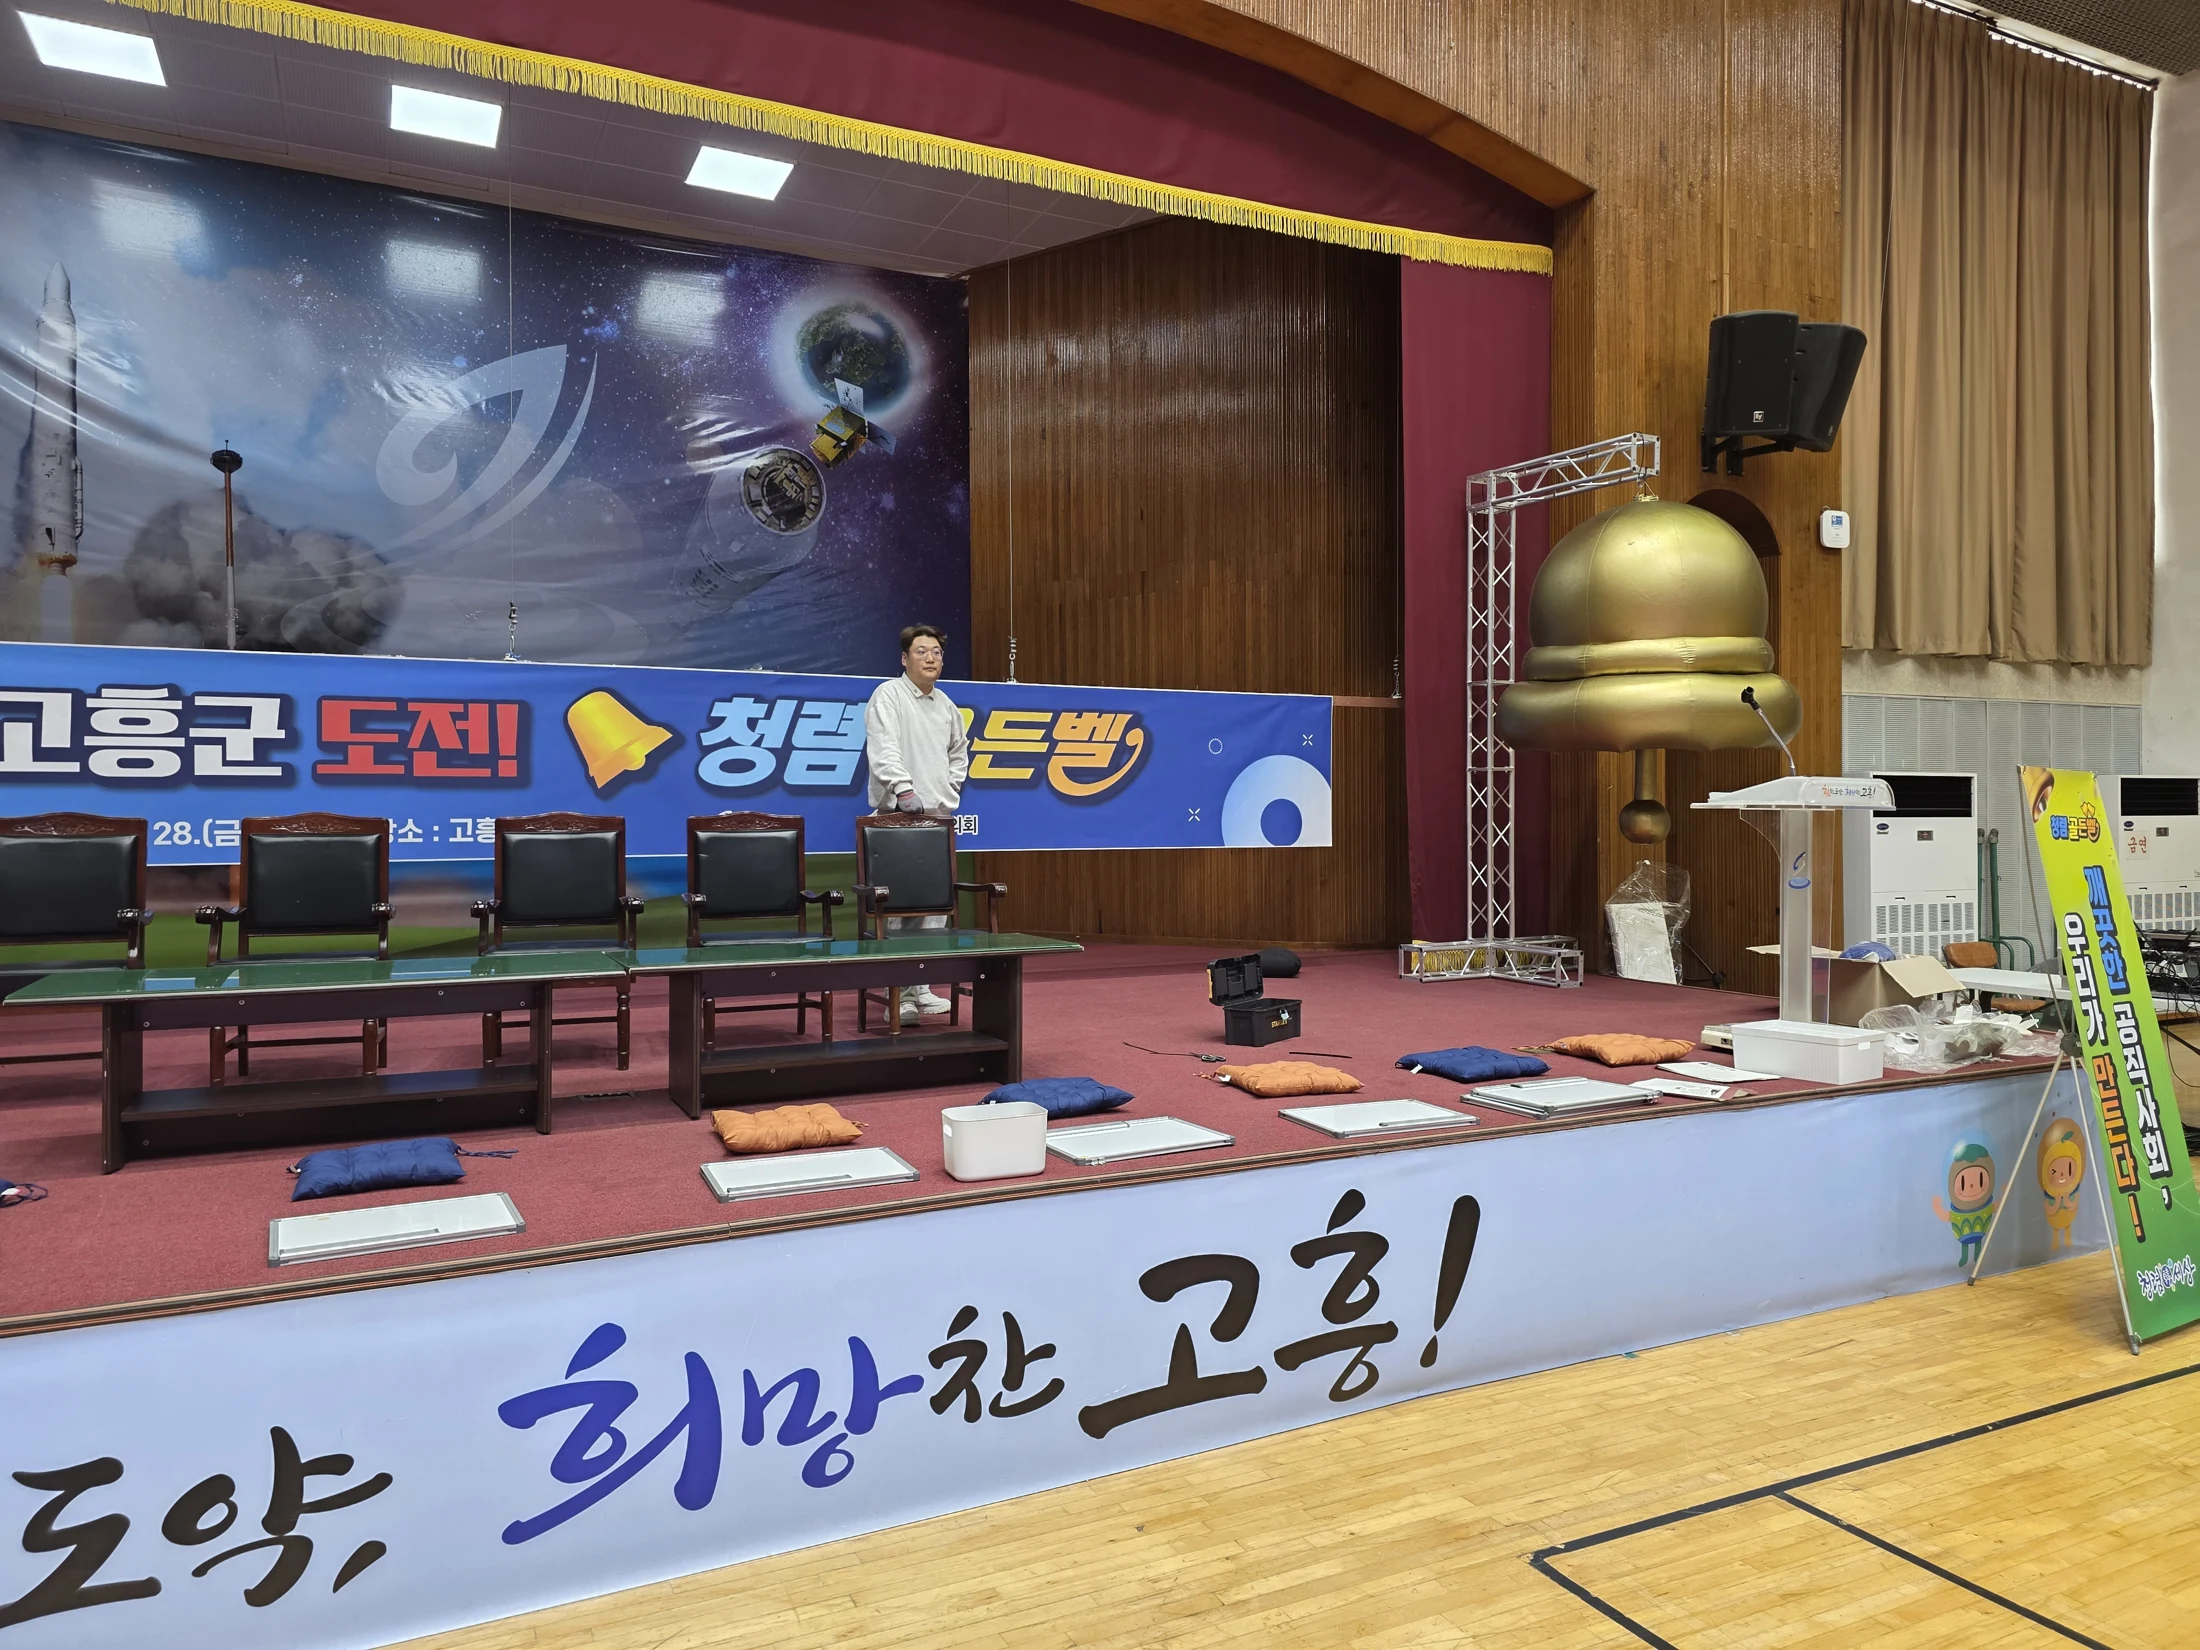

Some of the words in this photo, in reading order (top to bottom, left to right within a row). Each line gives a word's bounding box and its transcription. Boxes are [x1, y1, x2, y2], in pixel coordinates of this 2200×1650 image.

[0, 686, 286, 778] 고흥군
[316, 700, 518, 778] 도전!
[697, 696, 868, 787] 청렴
[957, 707, 1144, 797] 든벨
[388, 818, 423, 843] 소
[2127, 836, 2147, 854] 금연
[2083, 866, 2129, 994] 깨끗한
[2064, 912, 2106, 1044] 우리가
[2092, 1055, 2144, 1241] 만든다!
[0, 1426, 393, 1628] 도약,
[1078, 1189, 1481, 1440] 고흥!
